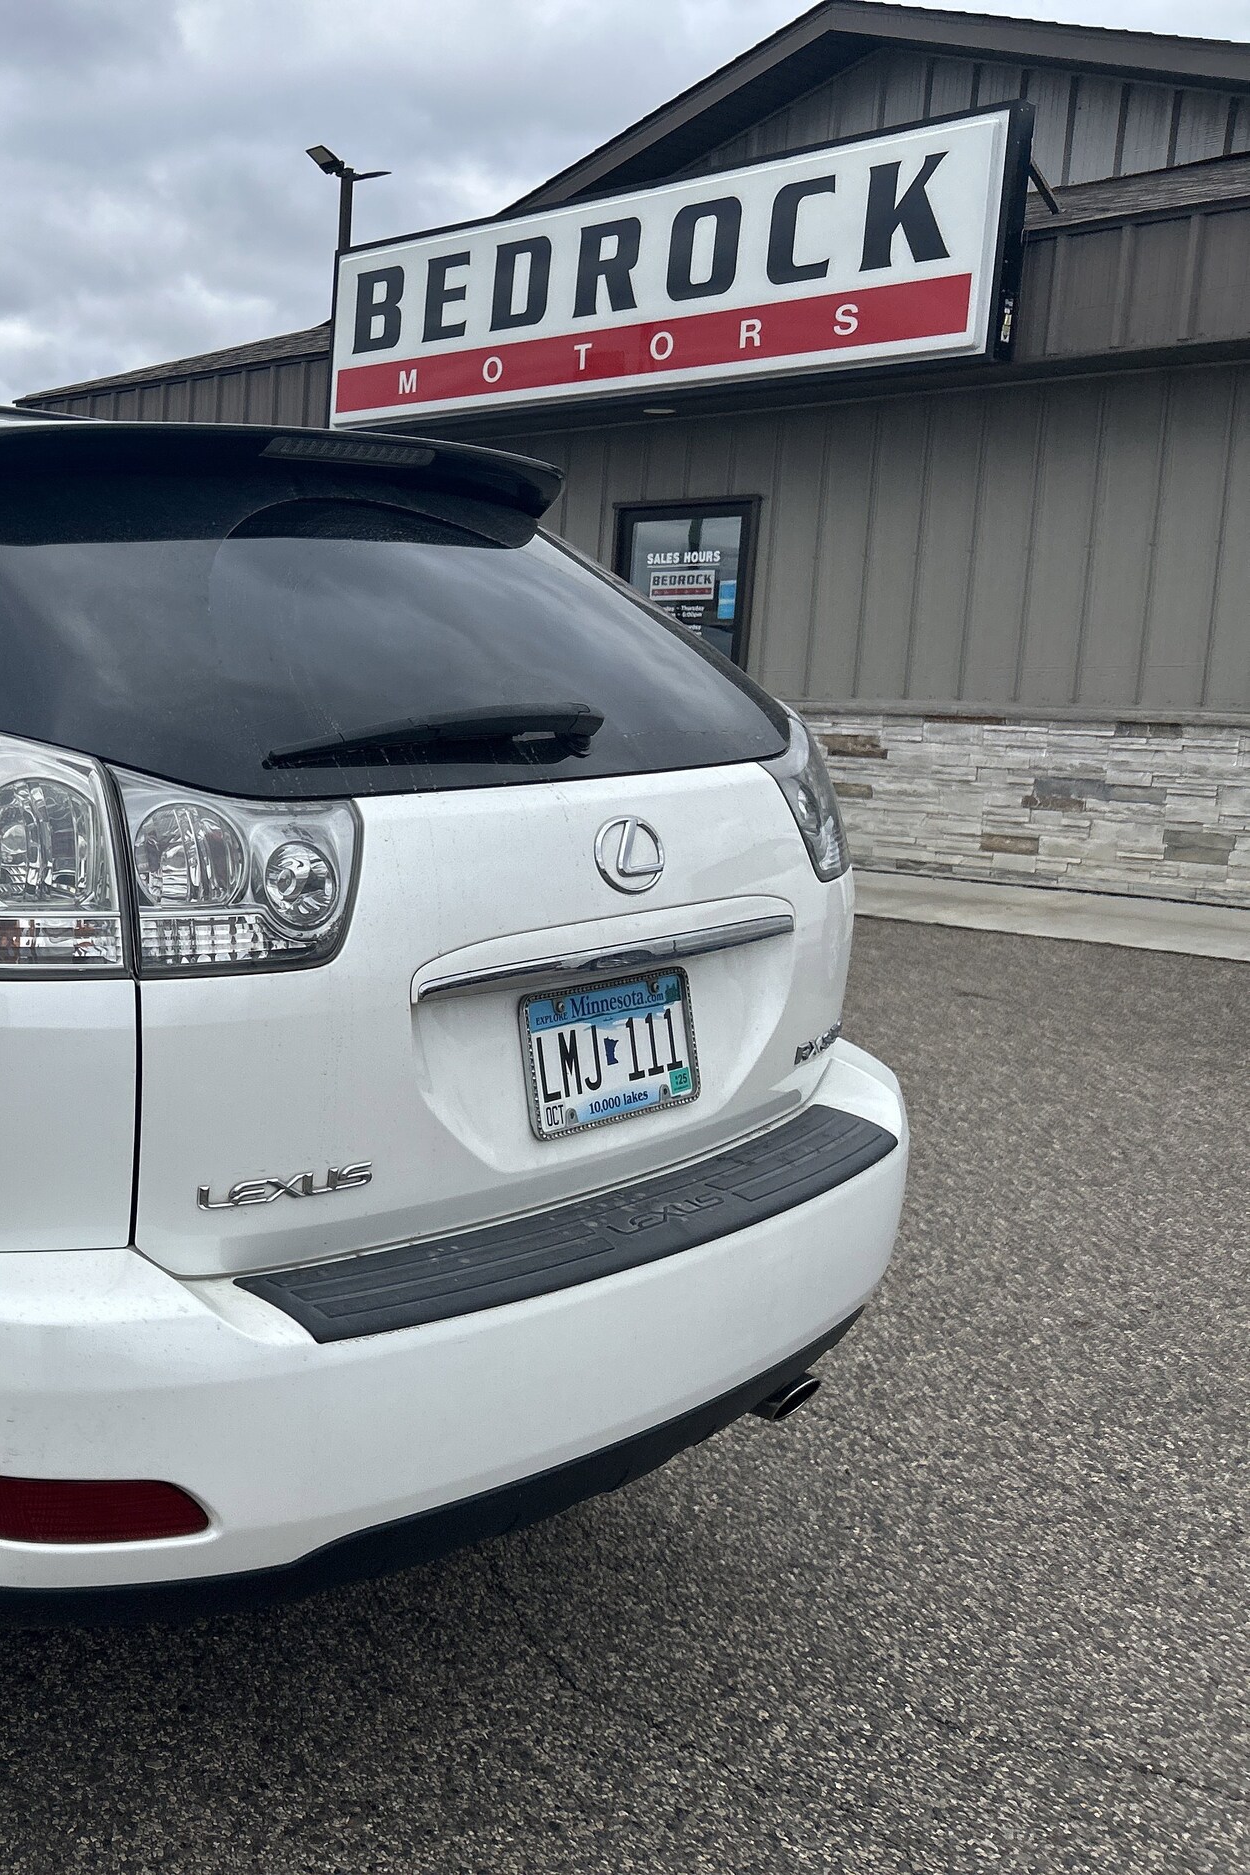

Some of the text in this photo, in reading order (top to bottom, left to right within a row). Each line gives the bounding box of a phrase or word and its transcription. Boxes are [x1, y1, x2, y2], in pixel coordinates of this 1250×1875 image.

[352, 151, 950, 355] BEDROCK
[398, 303, 859, 395] MOTORS
[646, 550, 721, 565] SALES HOURS
[652, 574, 712, 586] BEDROCK
[535, 1011, 569, 1026] EXPLORE
[536, 1008, 683, 1103] LMJ 111
[546, 1104, 564, 1127] OCT
[589, 1090, 649, 1114] 10,000 lakes
[197, 1161, 372, 1210] LEXUS
[606, 1193, 725, 1235] LEXUS
